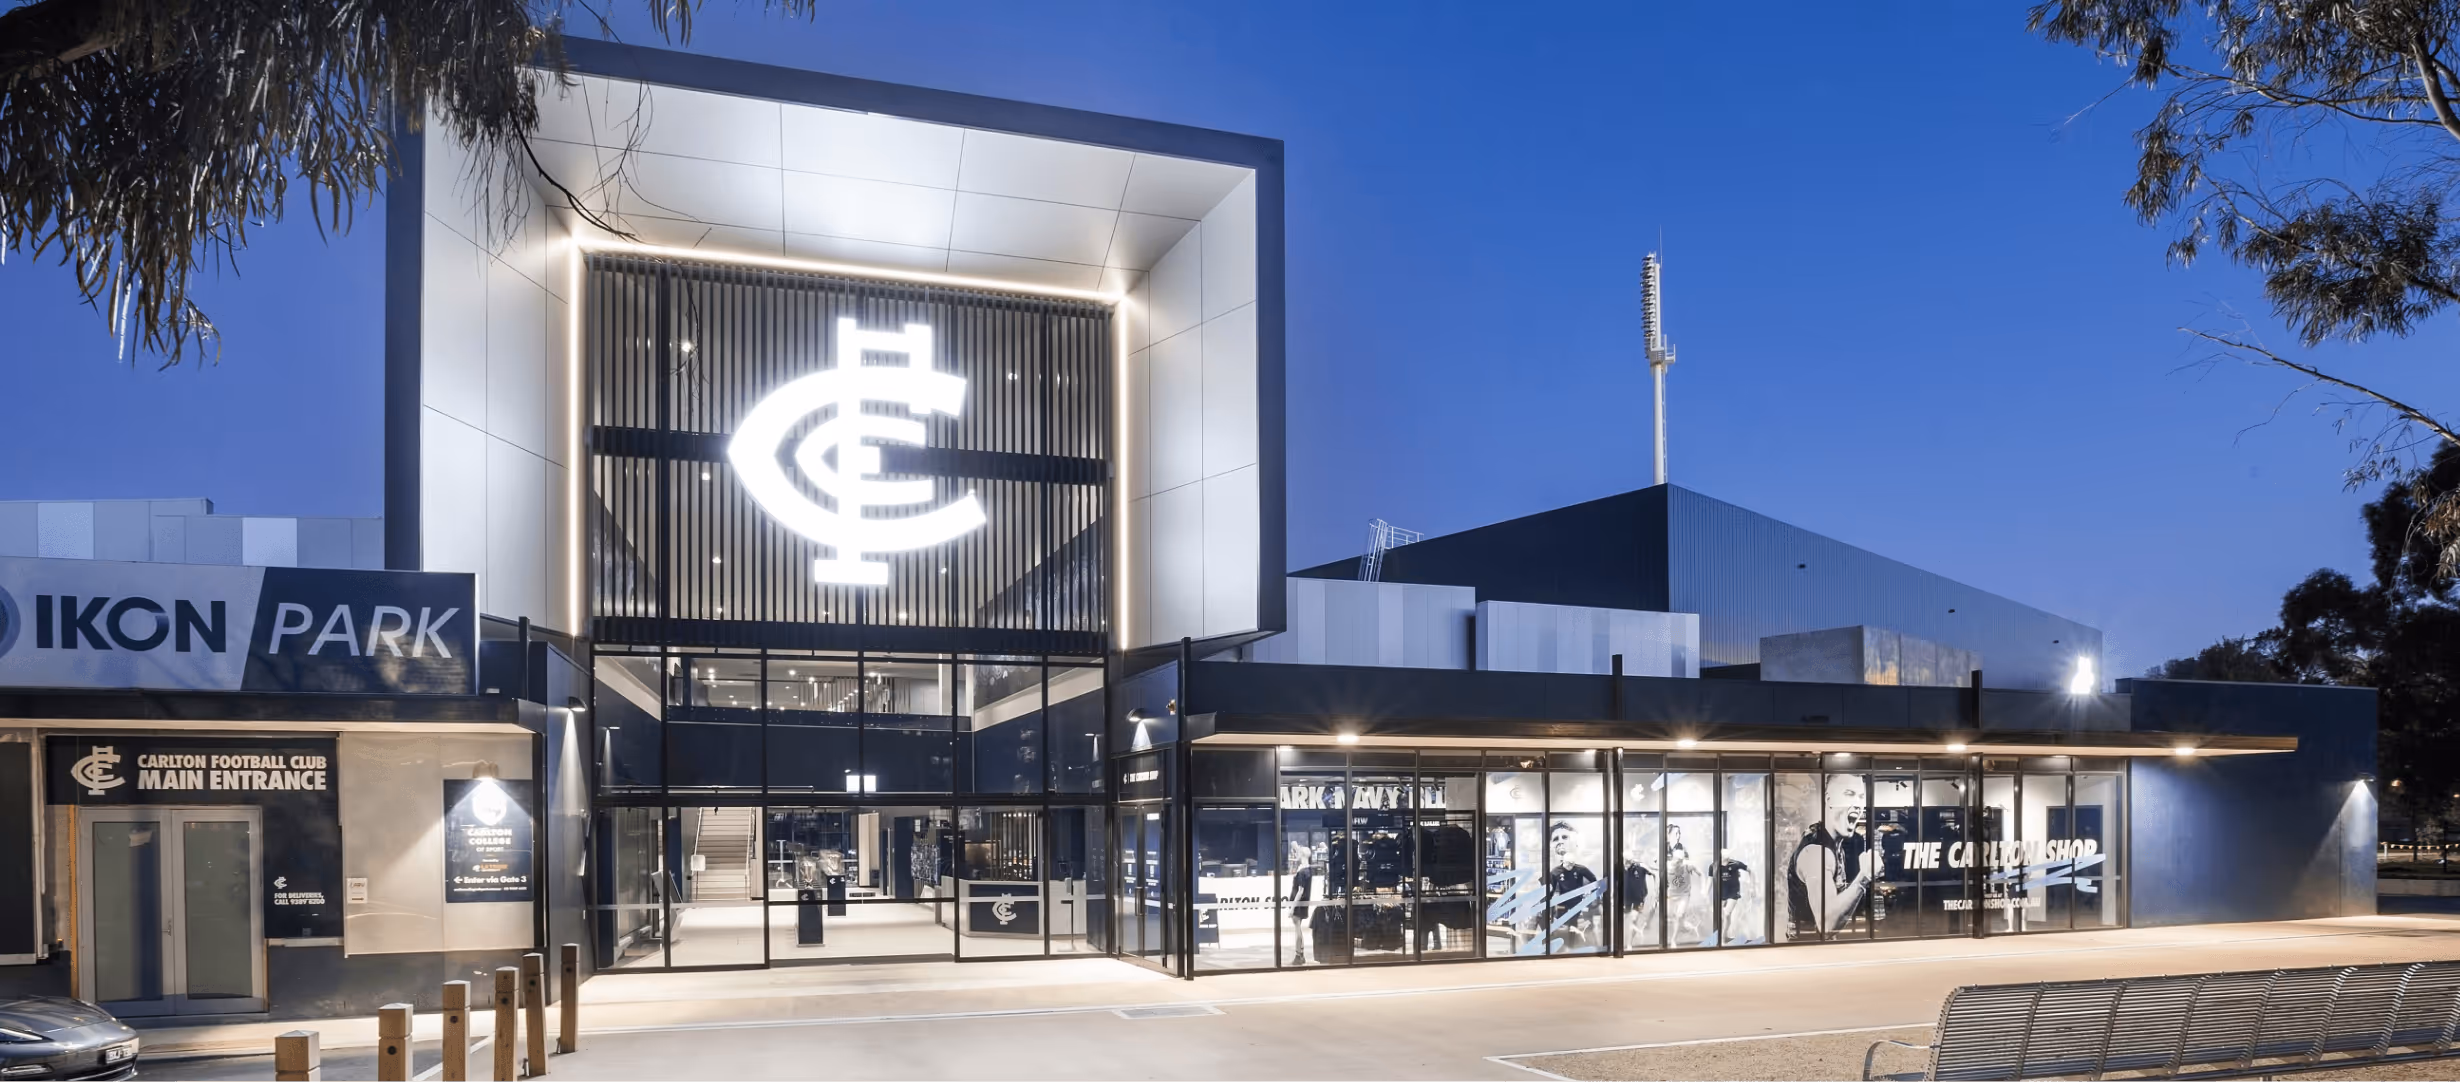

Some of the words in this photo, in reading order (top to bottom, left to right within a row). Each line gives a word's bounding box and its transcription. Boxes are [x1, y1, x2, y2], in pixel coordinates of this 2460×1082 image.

[35, 594, 227, 653] IKON
[269, 602, 461, 659] PARK
[137, 754, 206, 769] CARLTON
[211, 754, 286, 769] FOOTBALL
[290, 755, 327, 769] CLUB
[137, 770, 204, 790] MAIN
[209, 770, 326, 791] ENTRANCE
[1279, 786, 1327, 810] ARK
[1408, 786, 1447, 809] BLU
[1903, 841, 1943, 870] THE
[1947, 839, 2040, 869] CARLTON
[2045, 838, 2099, 862] SHOP
[500, 875, 520, 883] Gate
[521, 875, 527, 883] 3
